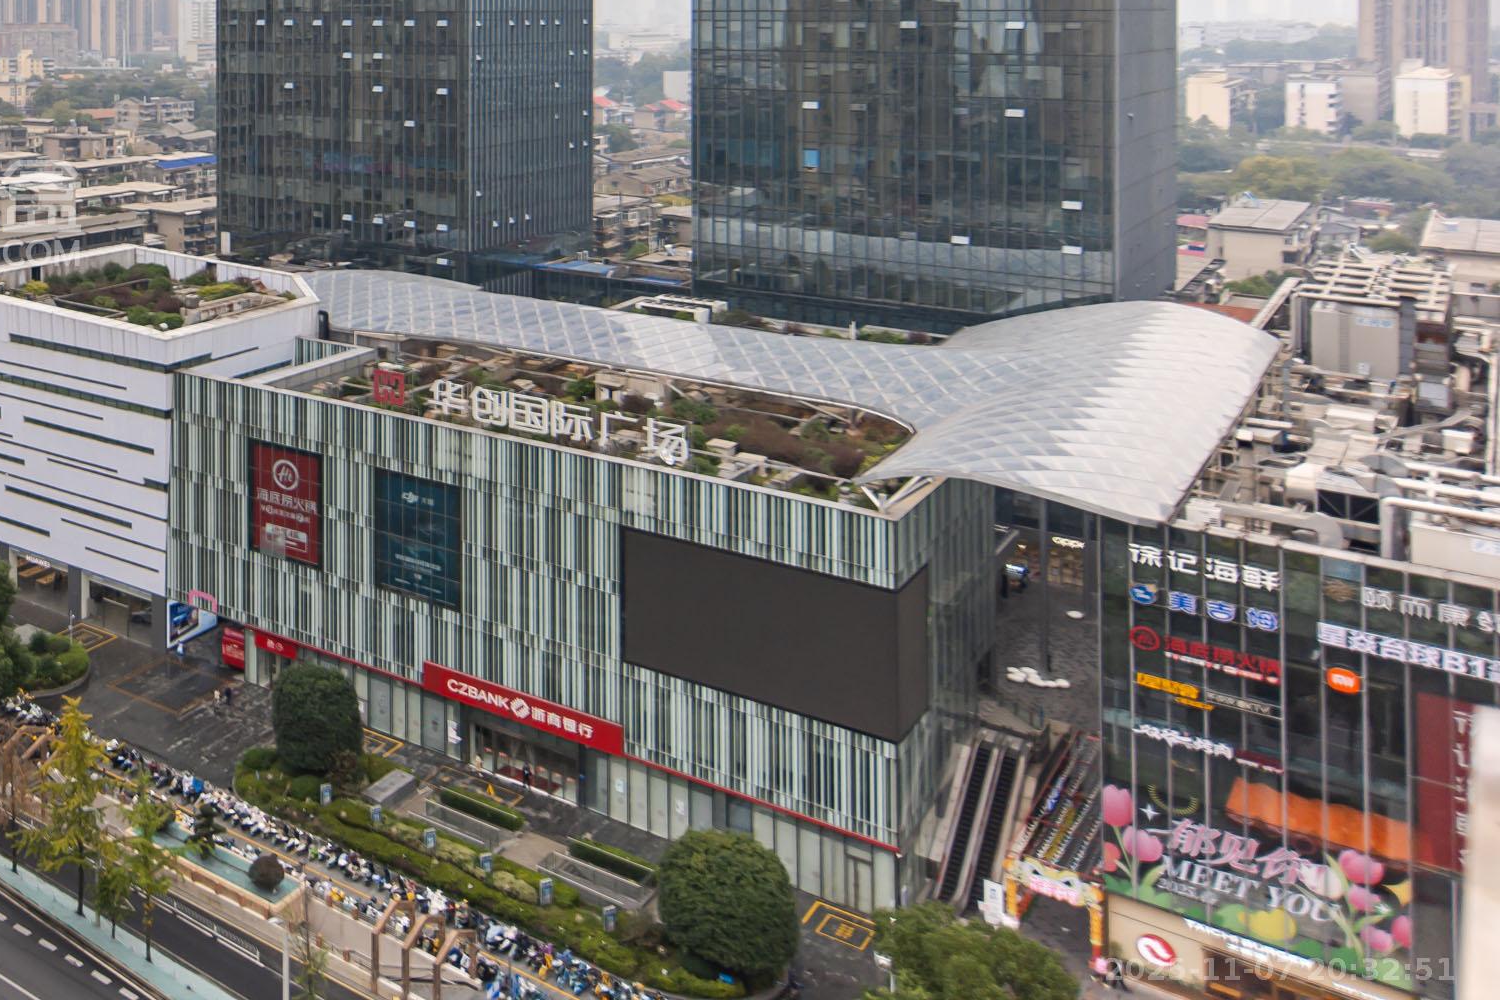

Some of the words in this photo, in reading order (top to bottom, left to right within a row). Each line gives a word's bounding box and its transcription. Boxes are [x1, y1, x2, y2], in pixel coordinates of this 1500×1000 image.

[426, 379, 688, 463] 华创国际广场
[1128, 543, 1281, 592] 徐记海鲜
[1168, 591, 1278, 632] 美吉姆
[447, 678, 511, 710] CZBANK
[531, 706, 594, 739] 浙商银行
[1162, 855, 1263, 898] MEET
[1268, 886, 1341, 922] YOU
